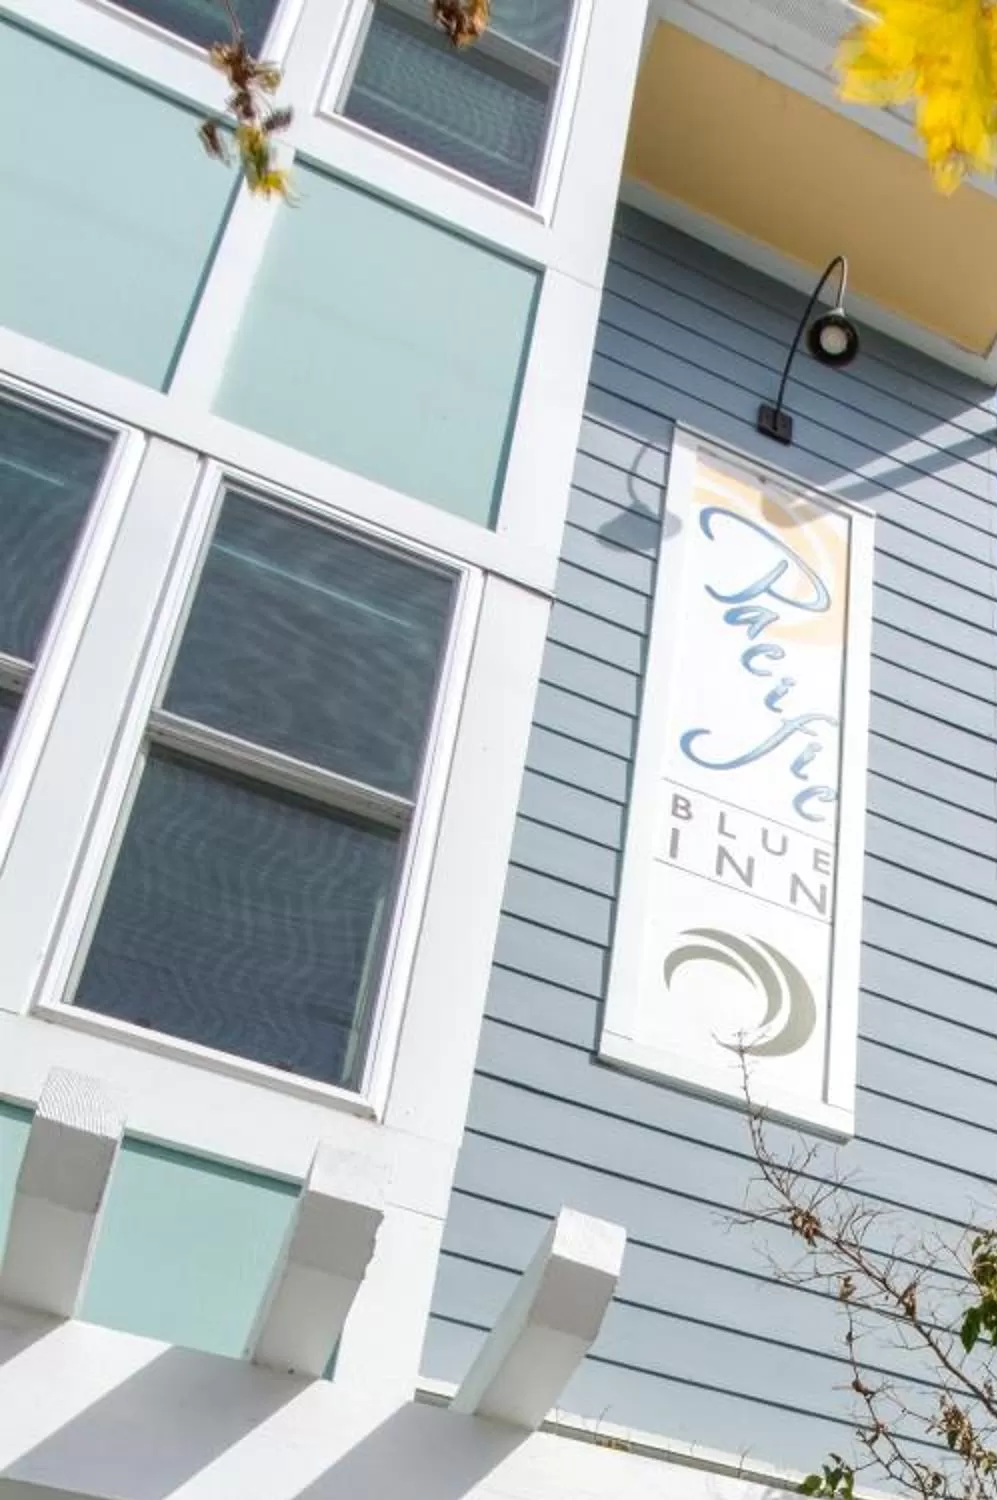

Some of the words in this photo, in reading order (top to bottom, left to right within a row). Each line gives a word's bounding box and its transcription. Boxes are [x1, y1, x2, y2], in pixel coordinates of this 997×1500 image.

[679, 506, 838, 822] Pacific
[669, 827, 828, 915] INN
[671, 793, 831, 876] BLUE
